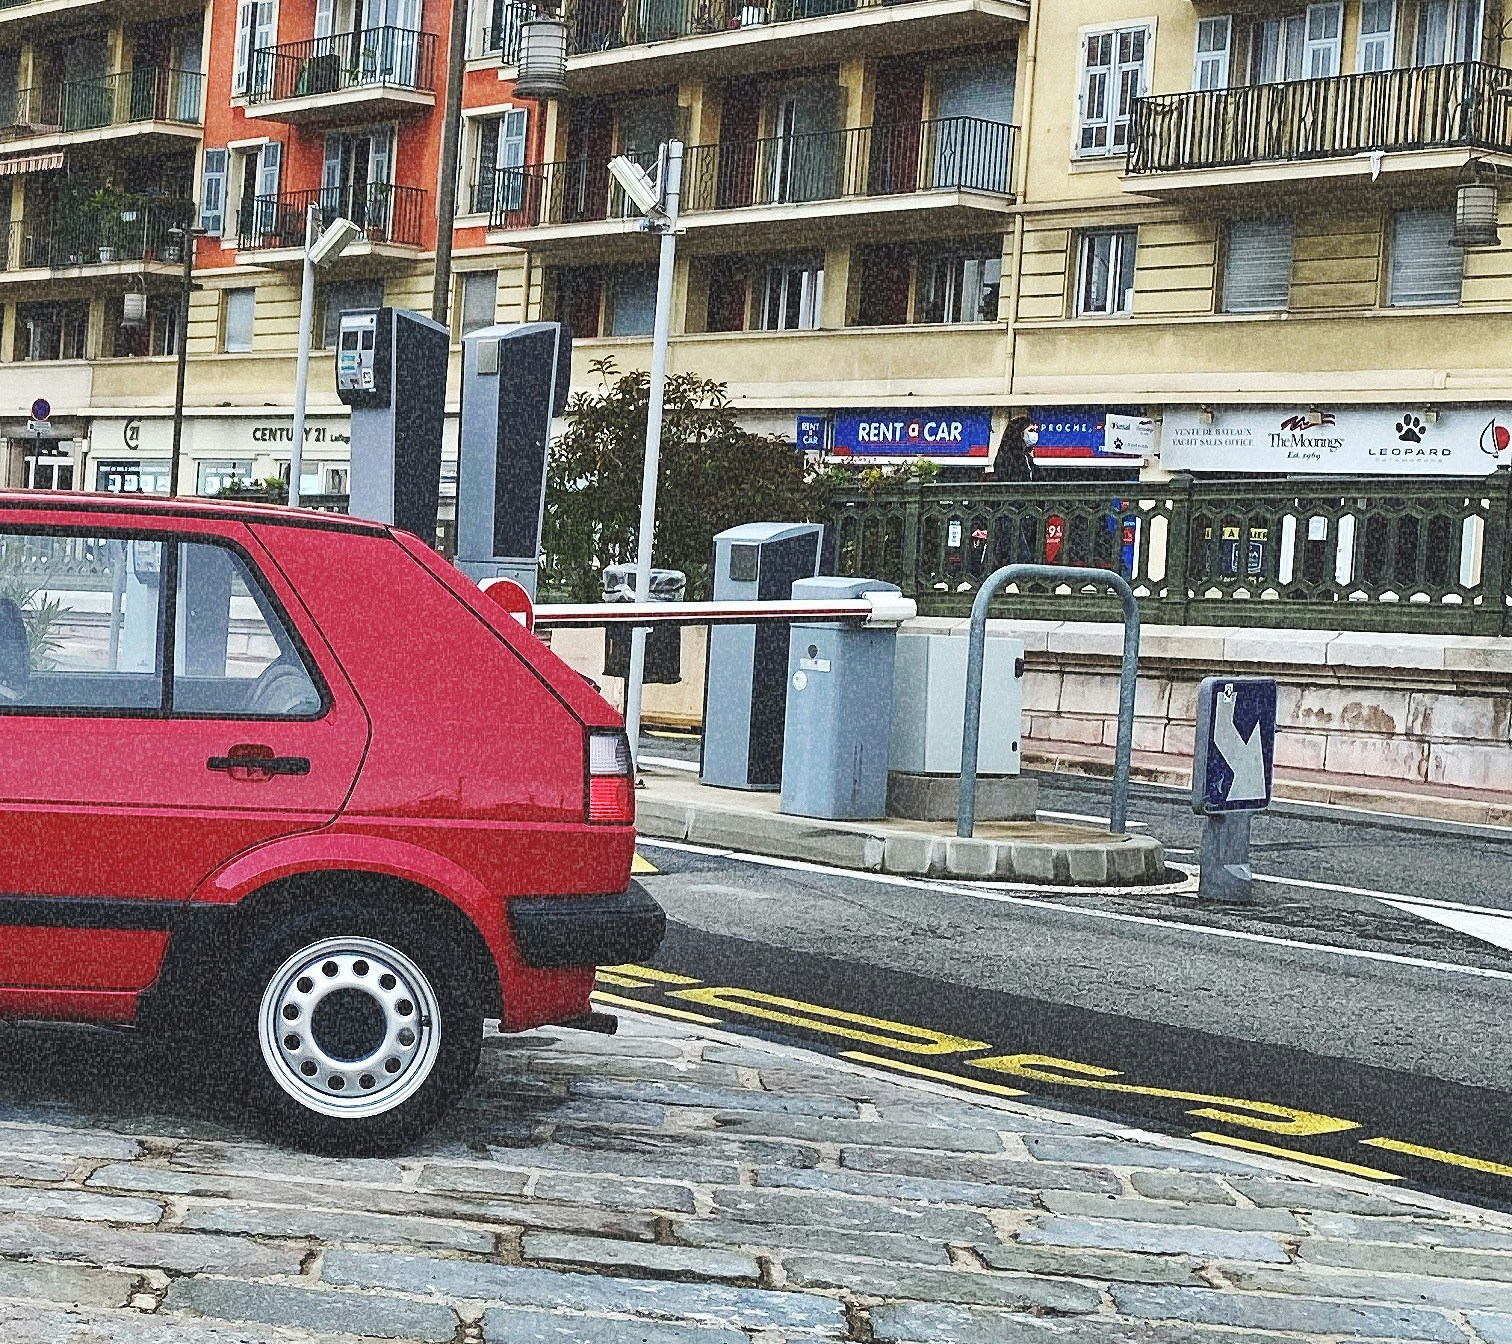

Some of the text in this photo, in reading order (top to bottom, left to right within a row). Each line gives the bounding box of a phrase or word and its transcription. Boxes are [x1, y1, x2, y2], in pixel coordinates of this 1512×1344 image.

[801, 422, 820, 431] RENT
[252, 427, 313, 442] CENTUY
[314, 427, 327, 442] 21
[858, 422, 904, 442] RENT
[923, 421, 963, 442] CAR
[1202, 428, 1213, 436] DE
[802, 435, 819, 445] CAR
[1199, 438, 1223, 446] SALES
[1224, 438, 1254, 446] OFFICE
[1268, 432, 1343, 453] The Moorings
[1368, 448, 1452, 457] LEOPARD
